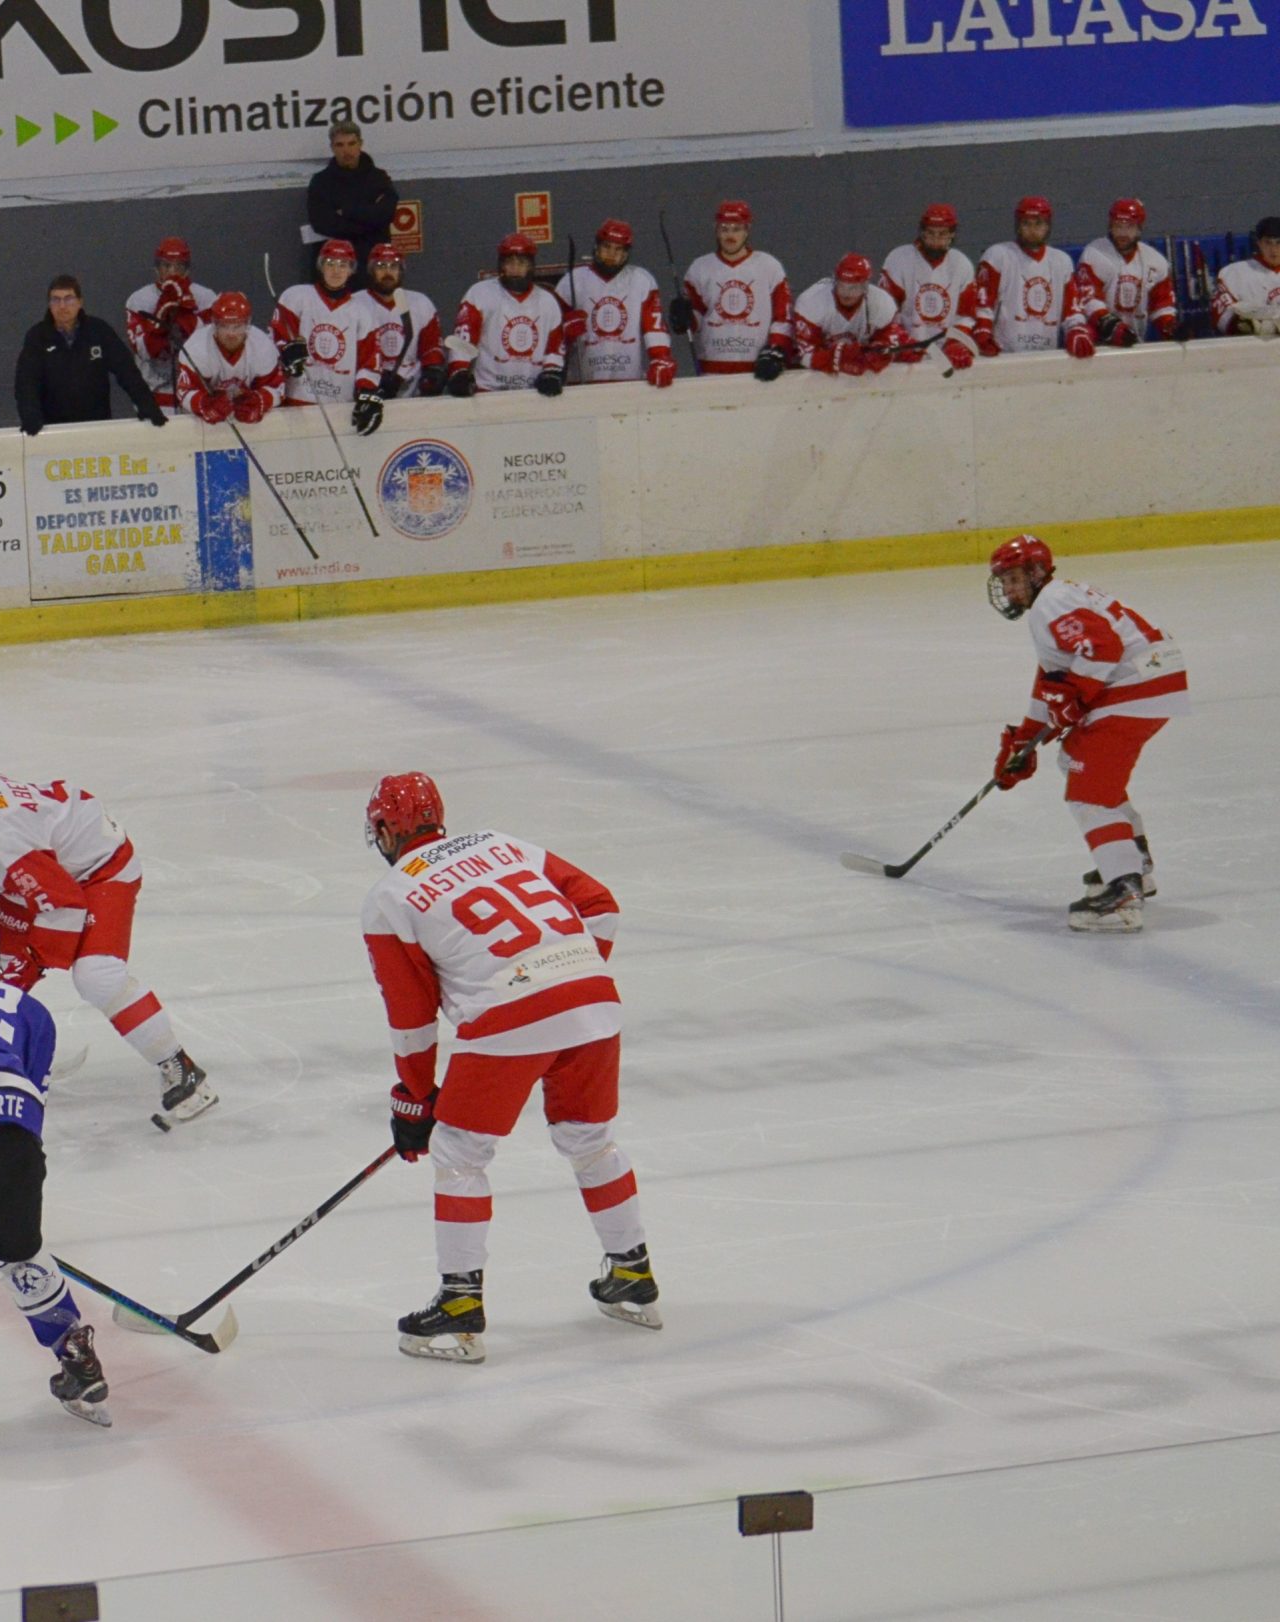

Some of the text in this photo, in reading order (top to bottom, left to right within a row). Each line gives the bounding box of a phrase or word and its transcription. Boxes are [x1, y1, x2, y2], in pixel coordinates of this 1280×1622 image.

[881, 0, 1267, 56] LATASA
[139, 72, 666, 139] Climatización eficiente
[44, 457, 112, 481] CREER
[503, 452, 566, 468] NEGUKO
[503, 469, 567, 484] KIROLEN
[64, 482, 158, 504] ES NUESTRO
[36, 511, 106, 531] DEPORTE
[38, 524, 184, 555] TALDEKIDEAK
[86, 551, 146, 576] GARA
[406, 855, 494, 913] GASTON
[451, 869, 585, 958] 95
[251, 1209, 320, 1271] CCM
